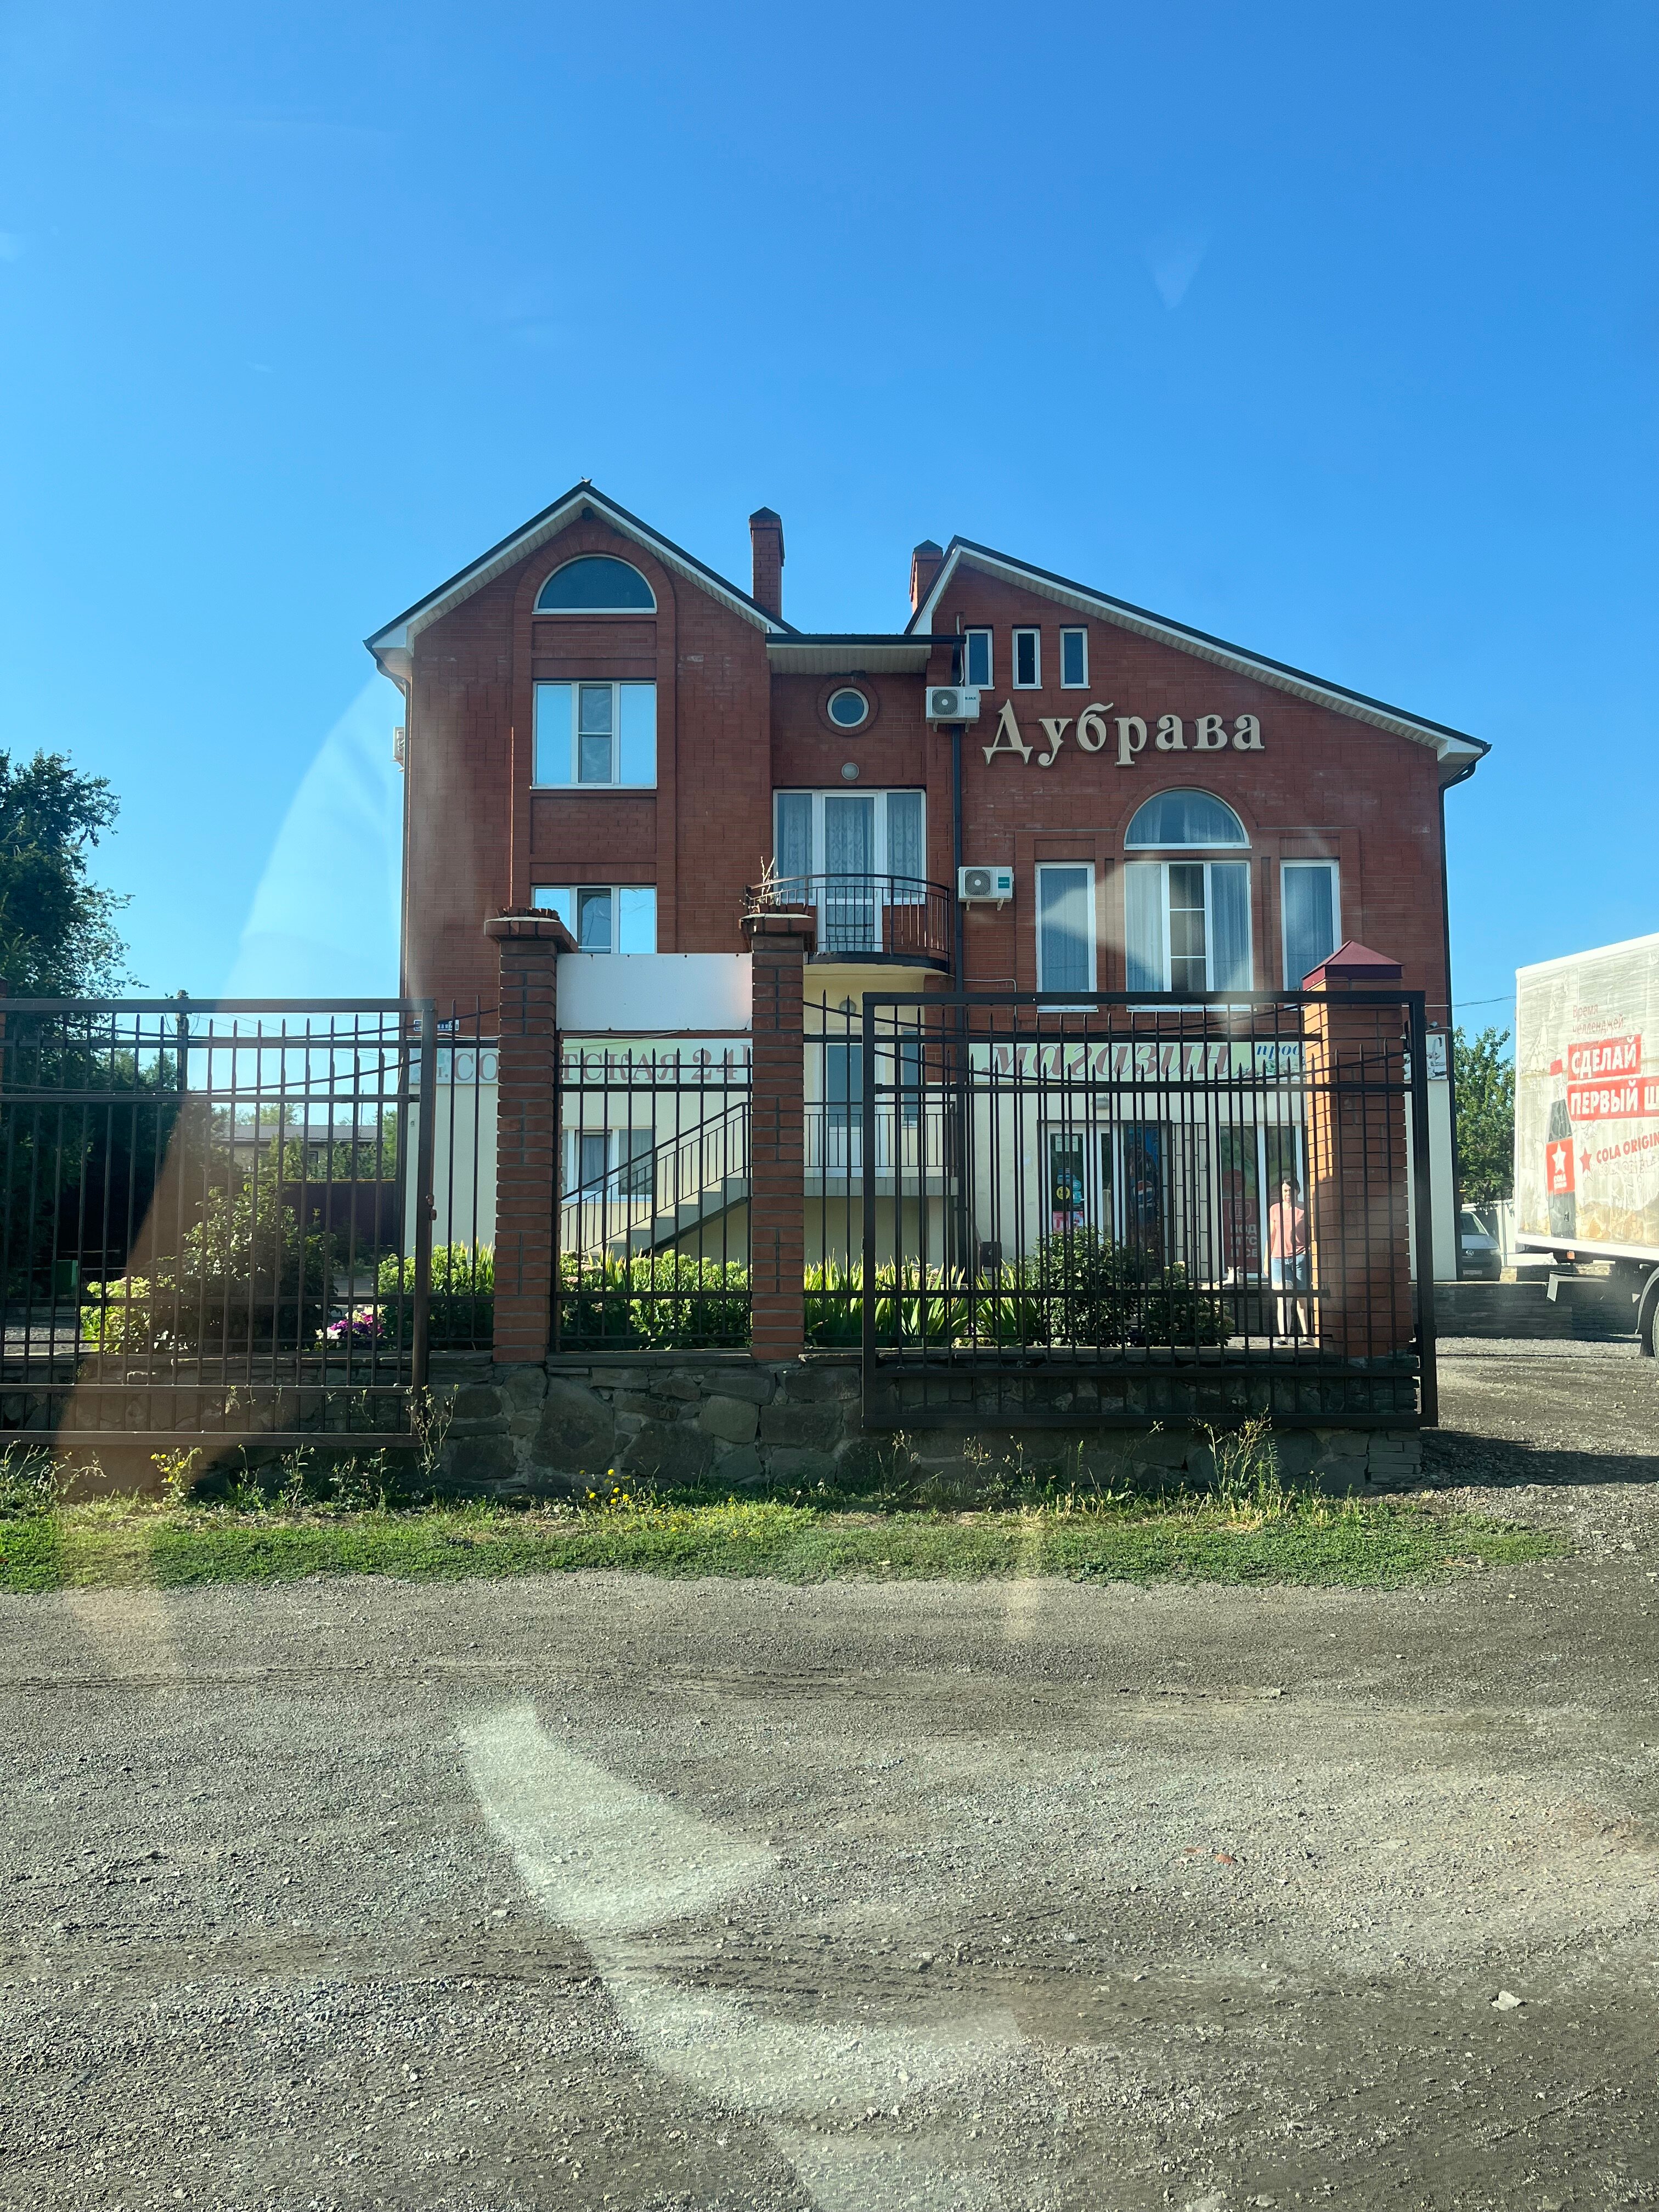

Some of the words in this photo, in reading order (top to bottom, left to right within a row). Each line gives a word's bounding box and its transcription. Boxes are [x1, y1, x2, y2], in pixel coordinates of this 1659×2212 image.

[981, 699, 1265, 767] Дубрава
[1573, 1005, 1598, 1020] Время
[455, 1053, 681, 1081] СОТСКАЯ
[981, 1045, 1229, 1076] магазин
[1571, 1036, 1637, 1079] СДЕЛАЙ
[1571, 1080, 1638, 1115] ПЕРВЫЙ
[1596, 1144, 1621, 1164] COLA
